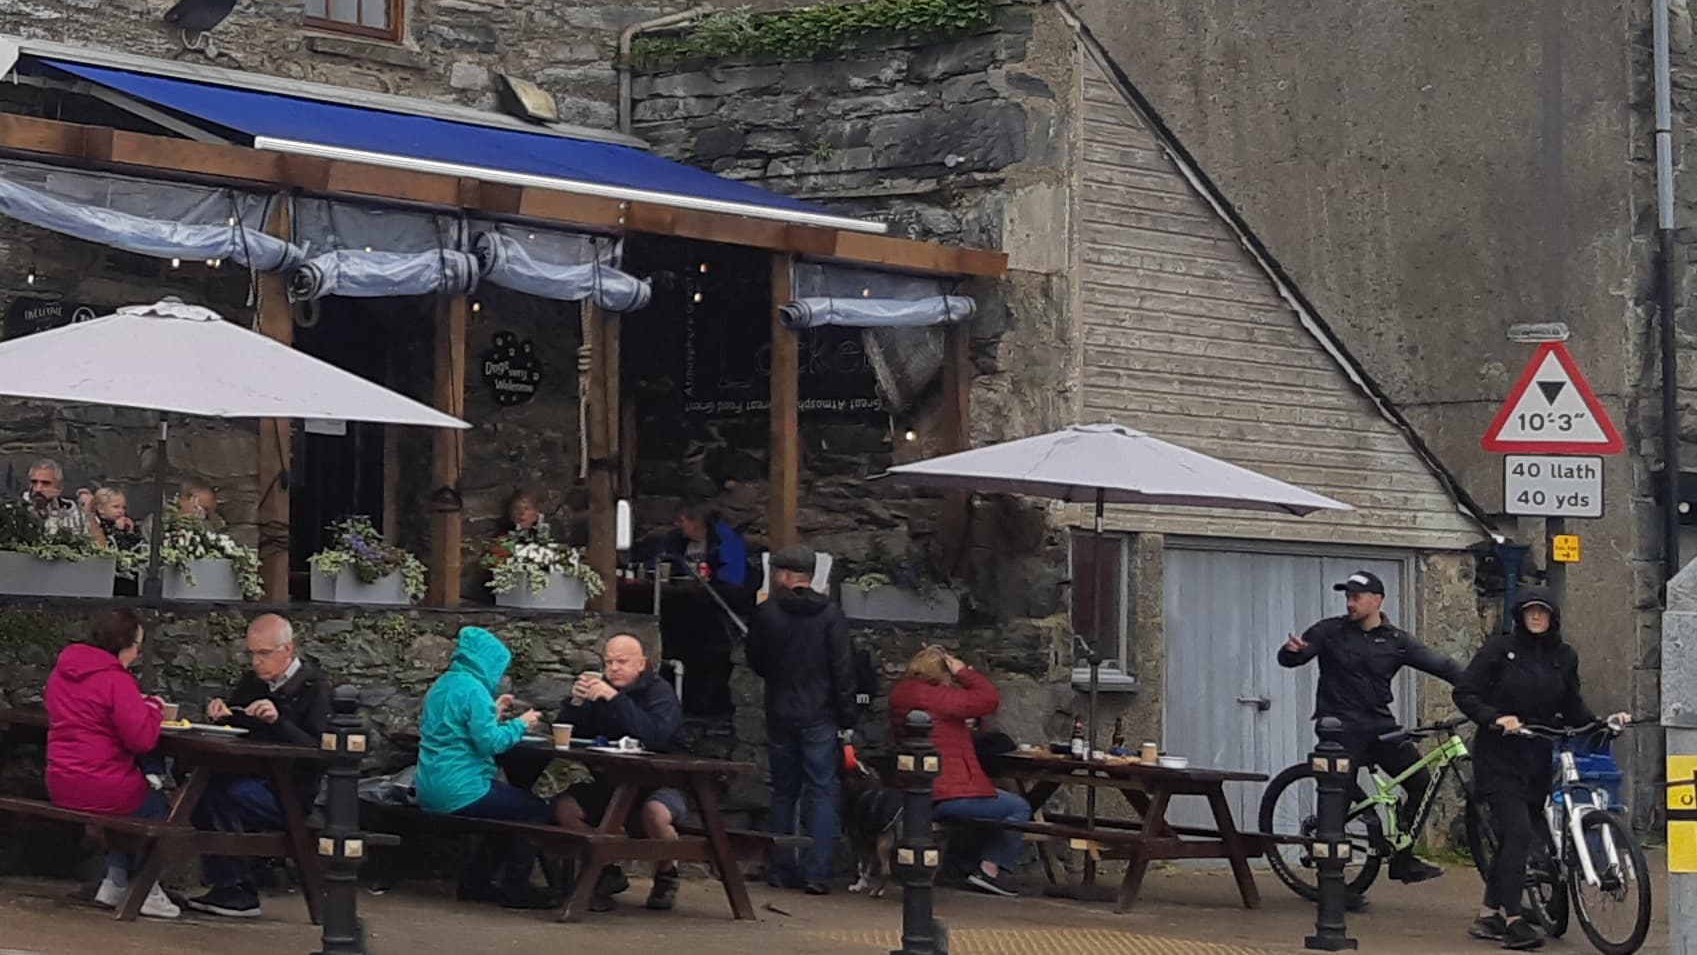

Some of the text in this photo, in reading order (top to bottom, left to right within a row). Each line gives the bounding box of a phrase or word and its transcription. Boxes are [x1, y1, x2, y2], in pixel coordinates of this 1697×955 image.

[485, 360, 510, 375] Dogs
[746, 399, 772, 411] reat
[850, 398, 883, 412] Great
[1512, 462, 1596, 479] 40 llath
[1517, 490, 1590, 509] 40 yds
